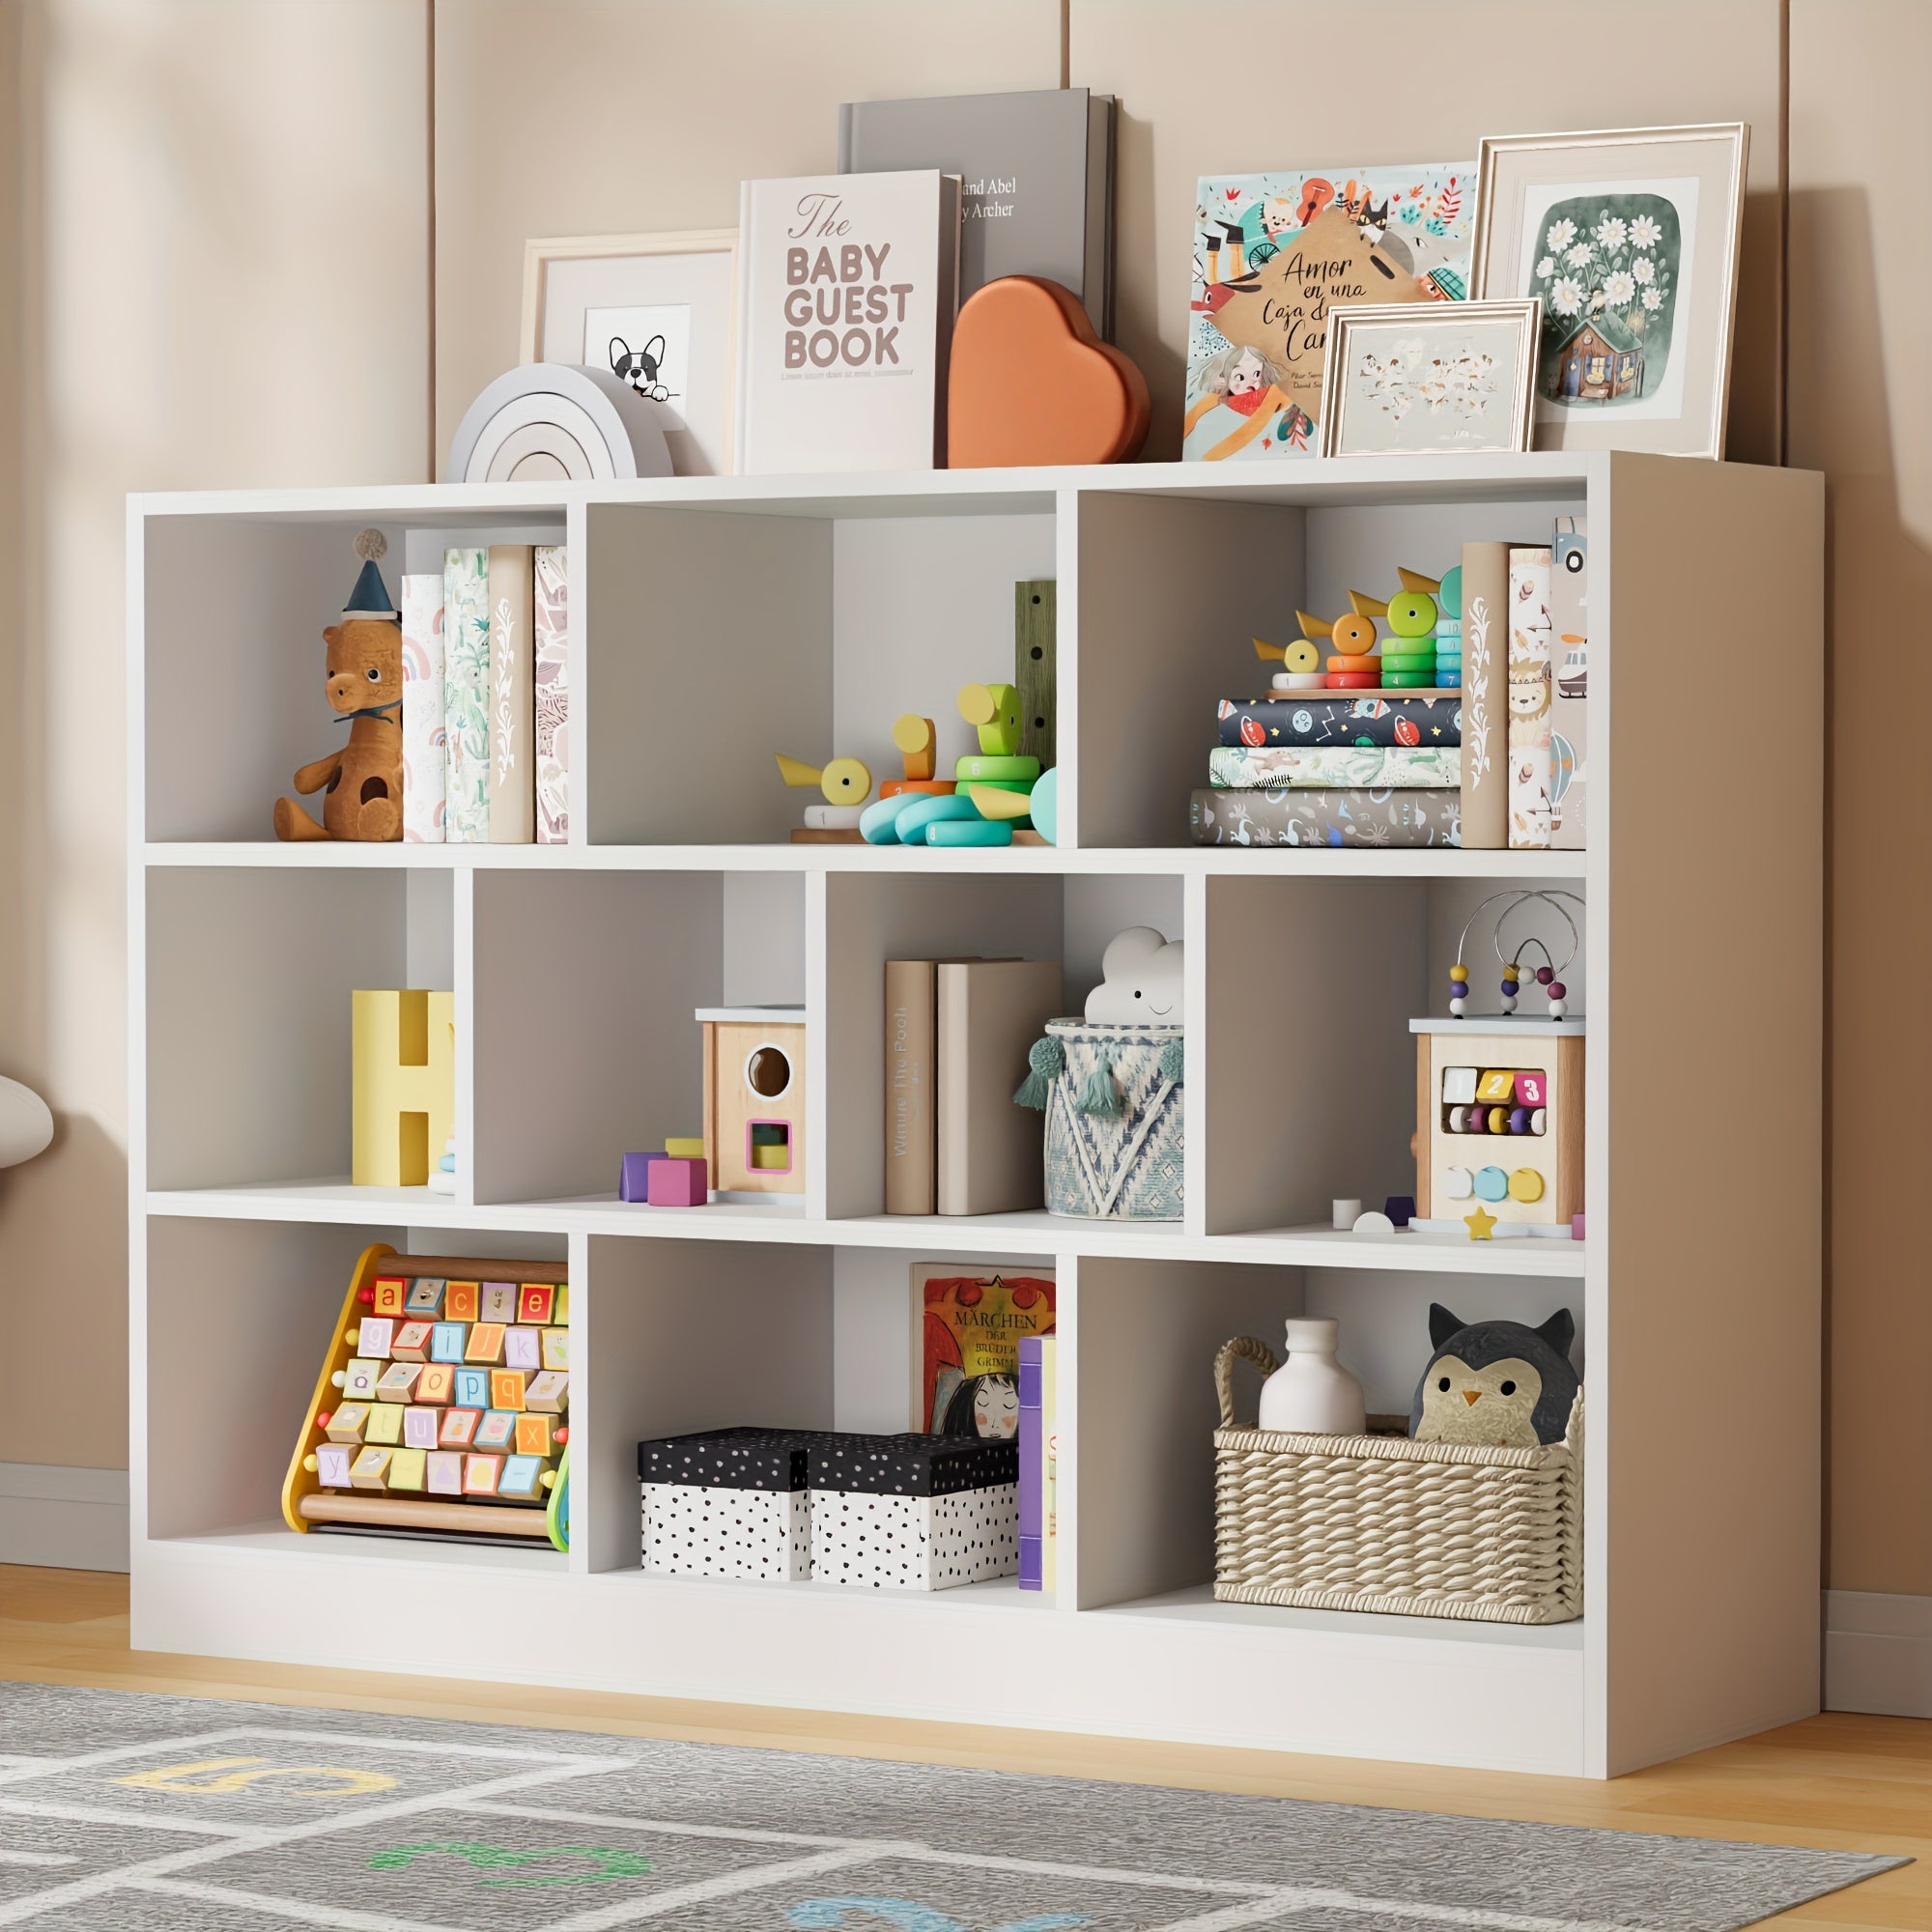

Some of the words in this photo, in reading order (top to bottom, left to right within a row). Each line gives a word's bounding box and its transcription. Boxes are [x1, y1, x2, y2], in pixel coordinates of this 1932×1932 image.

[962, 179, 984, 195] and
[986, 177, 1016, 194] Abel
[787, 192, 853, 240] The
[972, 201, 1014, 218] Archer
[787, 242, 891, 286] BABY
[1283, 252, 1352, 286] Amor
[1304, 285, 1324, 299] en
[1331, 284, 1366, 298] una
[784, 283, 914, 327] GUEST
[1263, 298, 1304, 331] Caja
[784, 326, 899, 369] BOOK
[1448, 675, 1455, 686] 7
[895, 1008, 907, 1052] Pooh
[895, 1059, 906, 1090] The
[1487, 1074, 1505, 1094] 2
[1523, 1079, 1540, 1101] 3
[382, 1288, 395, 1306] a
[454, 1293, 468, 1312] c
[528, 1293, 543, 1313] e
[953, 1310, 1037, 1330] MÄRCHEN
[369, 1324, 383, 1350] g
[985, 1330, 1007, 1341] DER
[977, 1356, 1013, 1369] GRIMM
[466, 1377, 479, 1402] p
[501, 1378, 516, 1406] q
[414, 1419, 427, 1438] u
[327, 1455, 341, 1480] y
